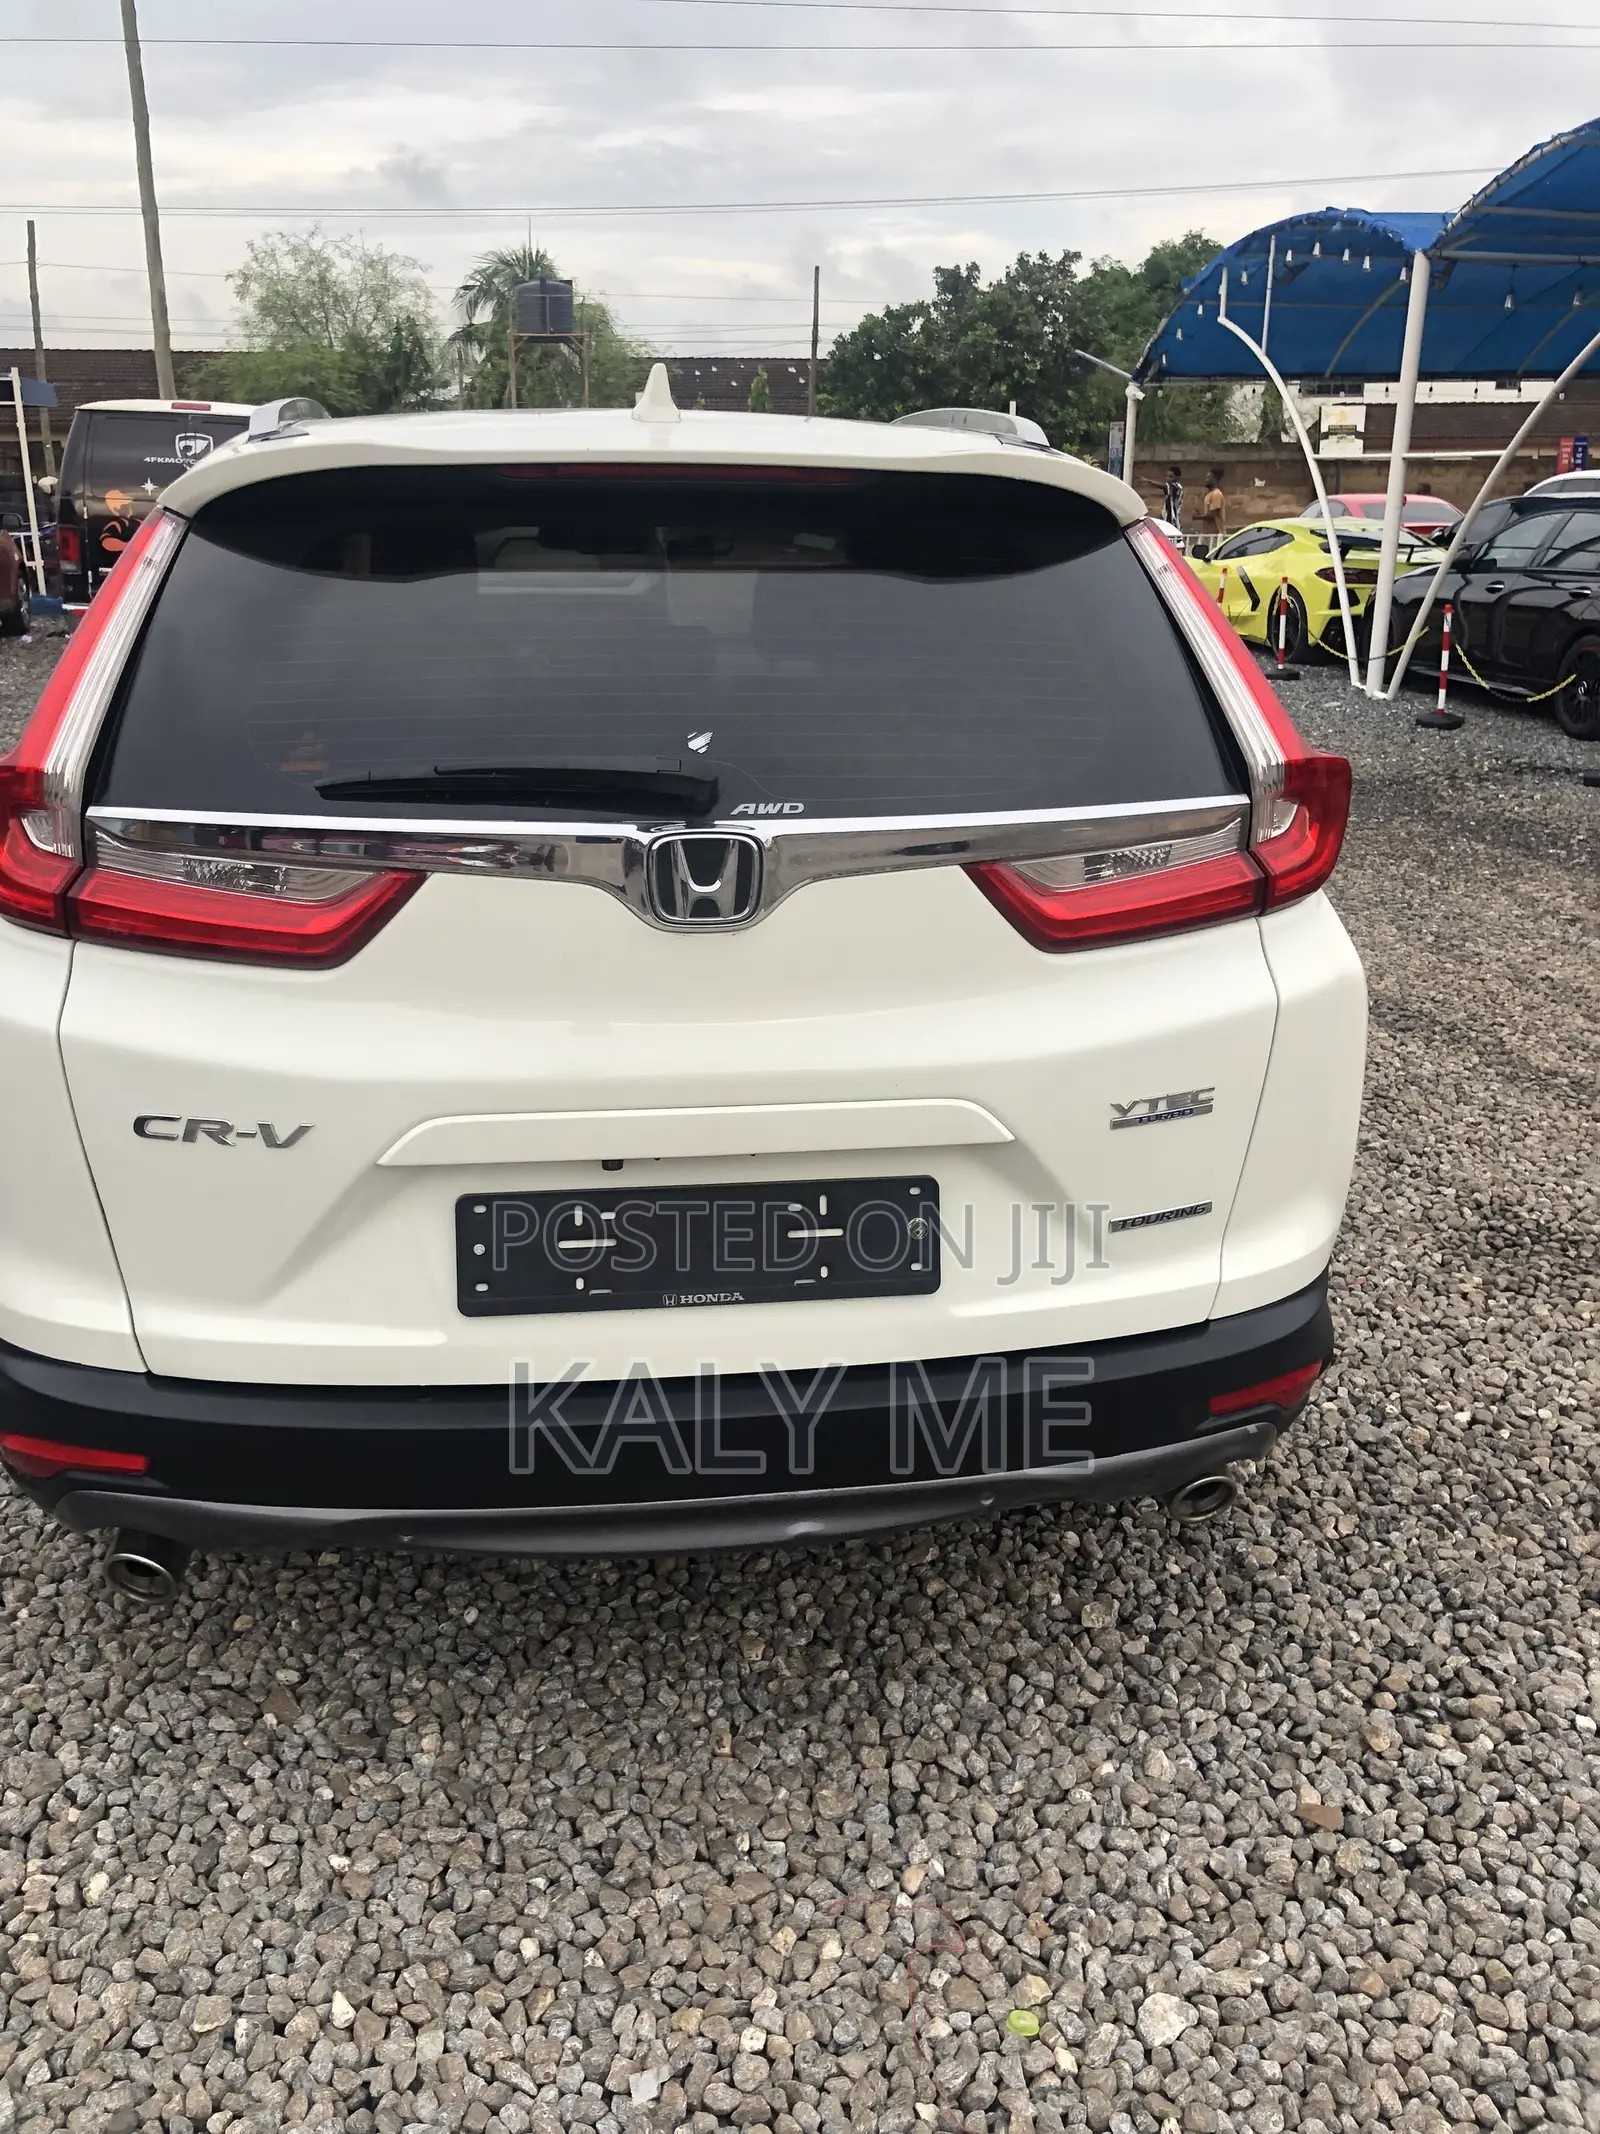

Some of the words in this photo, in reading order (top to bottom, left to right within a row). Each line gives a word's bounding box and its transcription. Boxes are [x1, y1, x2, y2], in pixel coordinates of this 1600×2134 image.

[730, 802, 804, 815] AWD
[1110, 1087, 1215, 1116] VTEC
[1134, 1108, 1193, 1126] TURBO
[133, 1112, 315, 1149] CR-V
[1117, 1202, 1208, 1230] TOURING
[679, 1292, 745, 1304] HONDA
